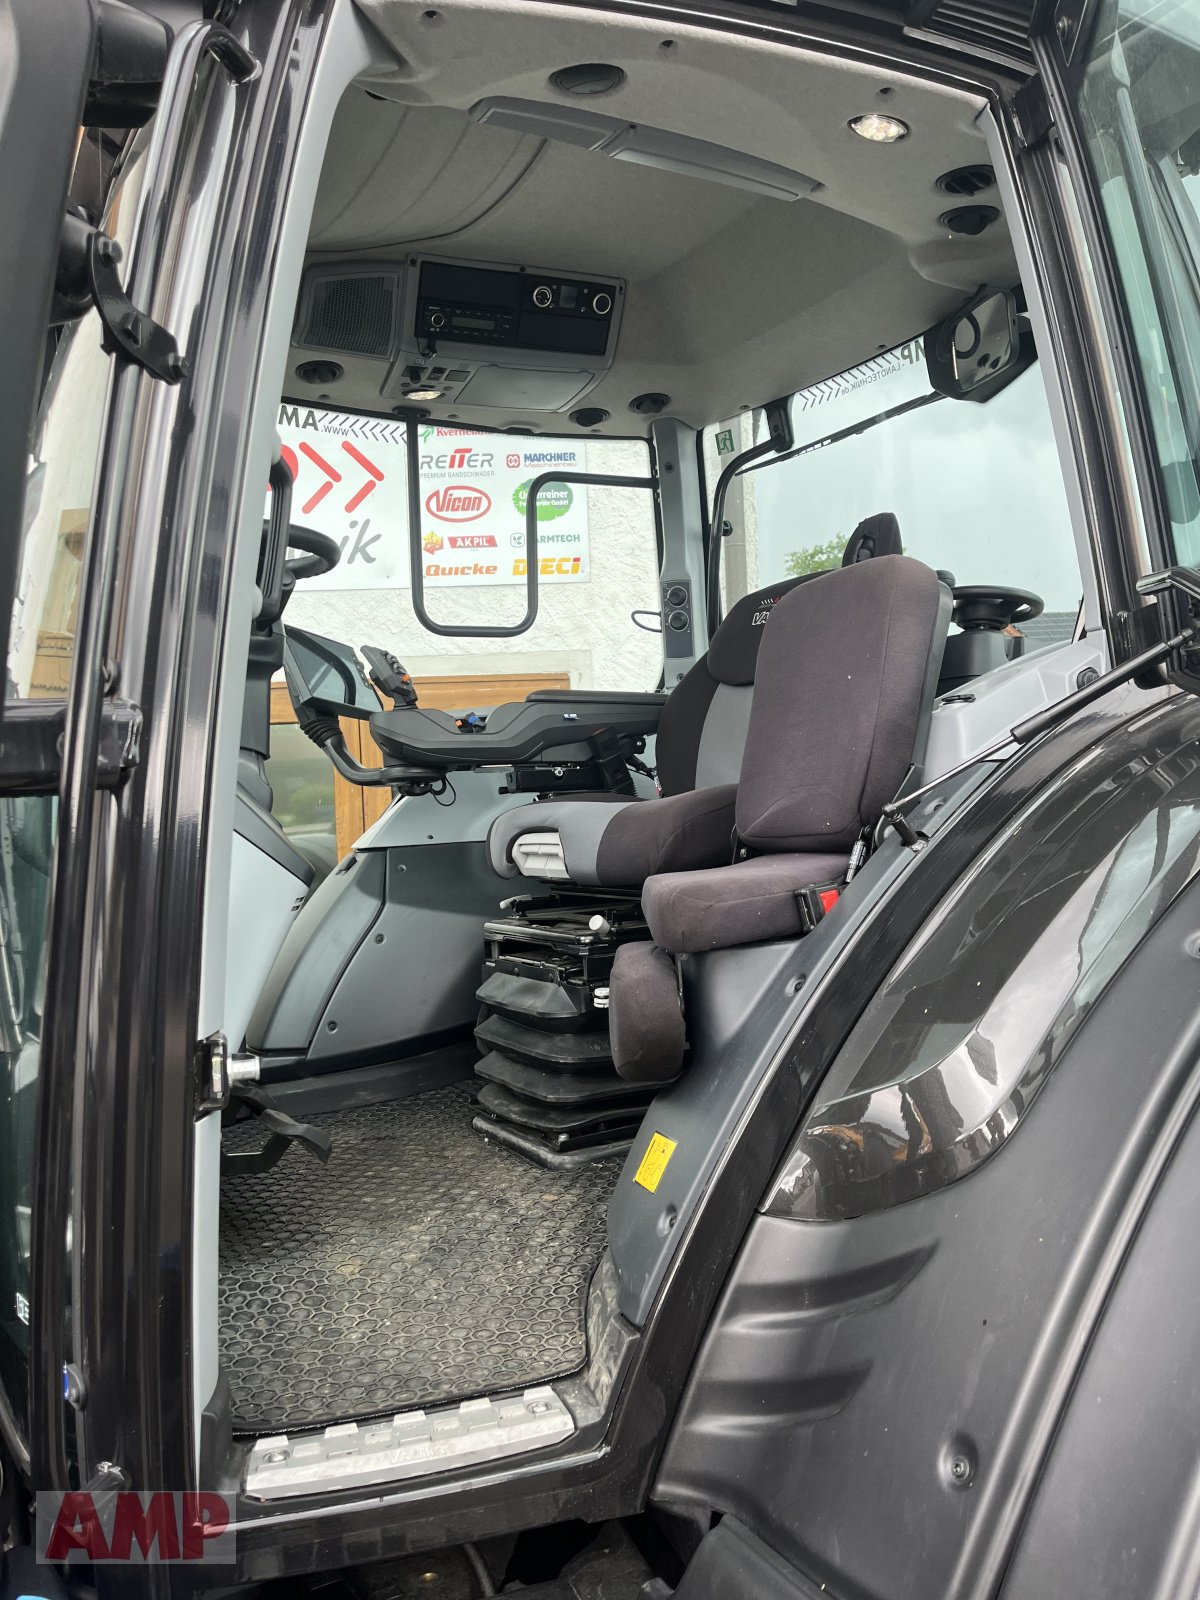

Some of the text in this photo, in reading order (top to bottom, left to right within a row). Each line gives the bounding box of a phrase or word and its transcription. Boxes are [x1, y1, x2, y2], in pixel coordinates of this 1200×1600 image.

[420, 448, 494, 469] REITER
[524, 452, 576, 462] MARCHNER
[435, 489, 483, 512] Vicon
[456, 537, 489, 547] AKPIL
[537, 534, 581, 543] RMTECH
[425, 563, 498, 576] Quicke
